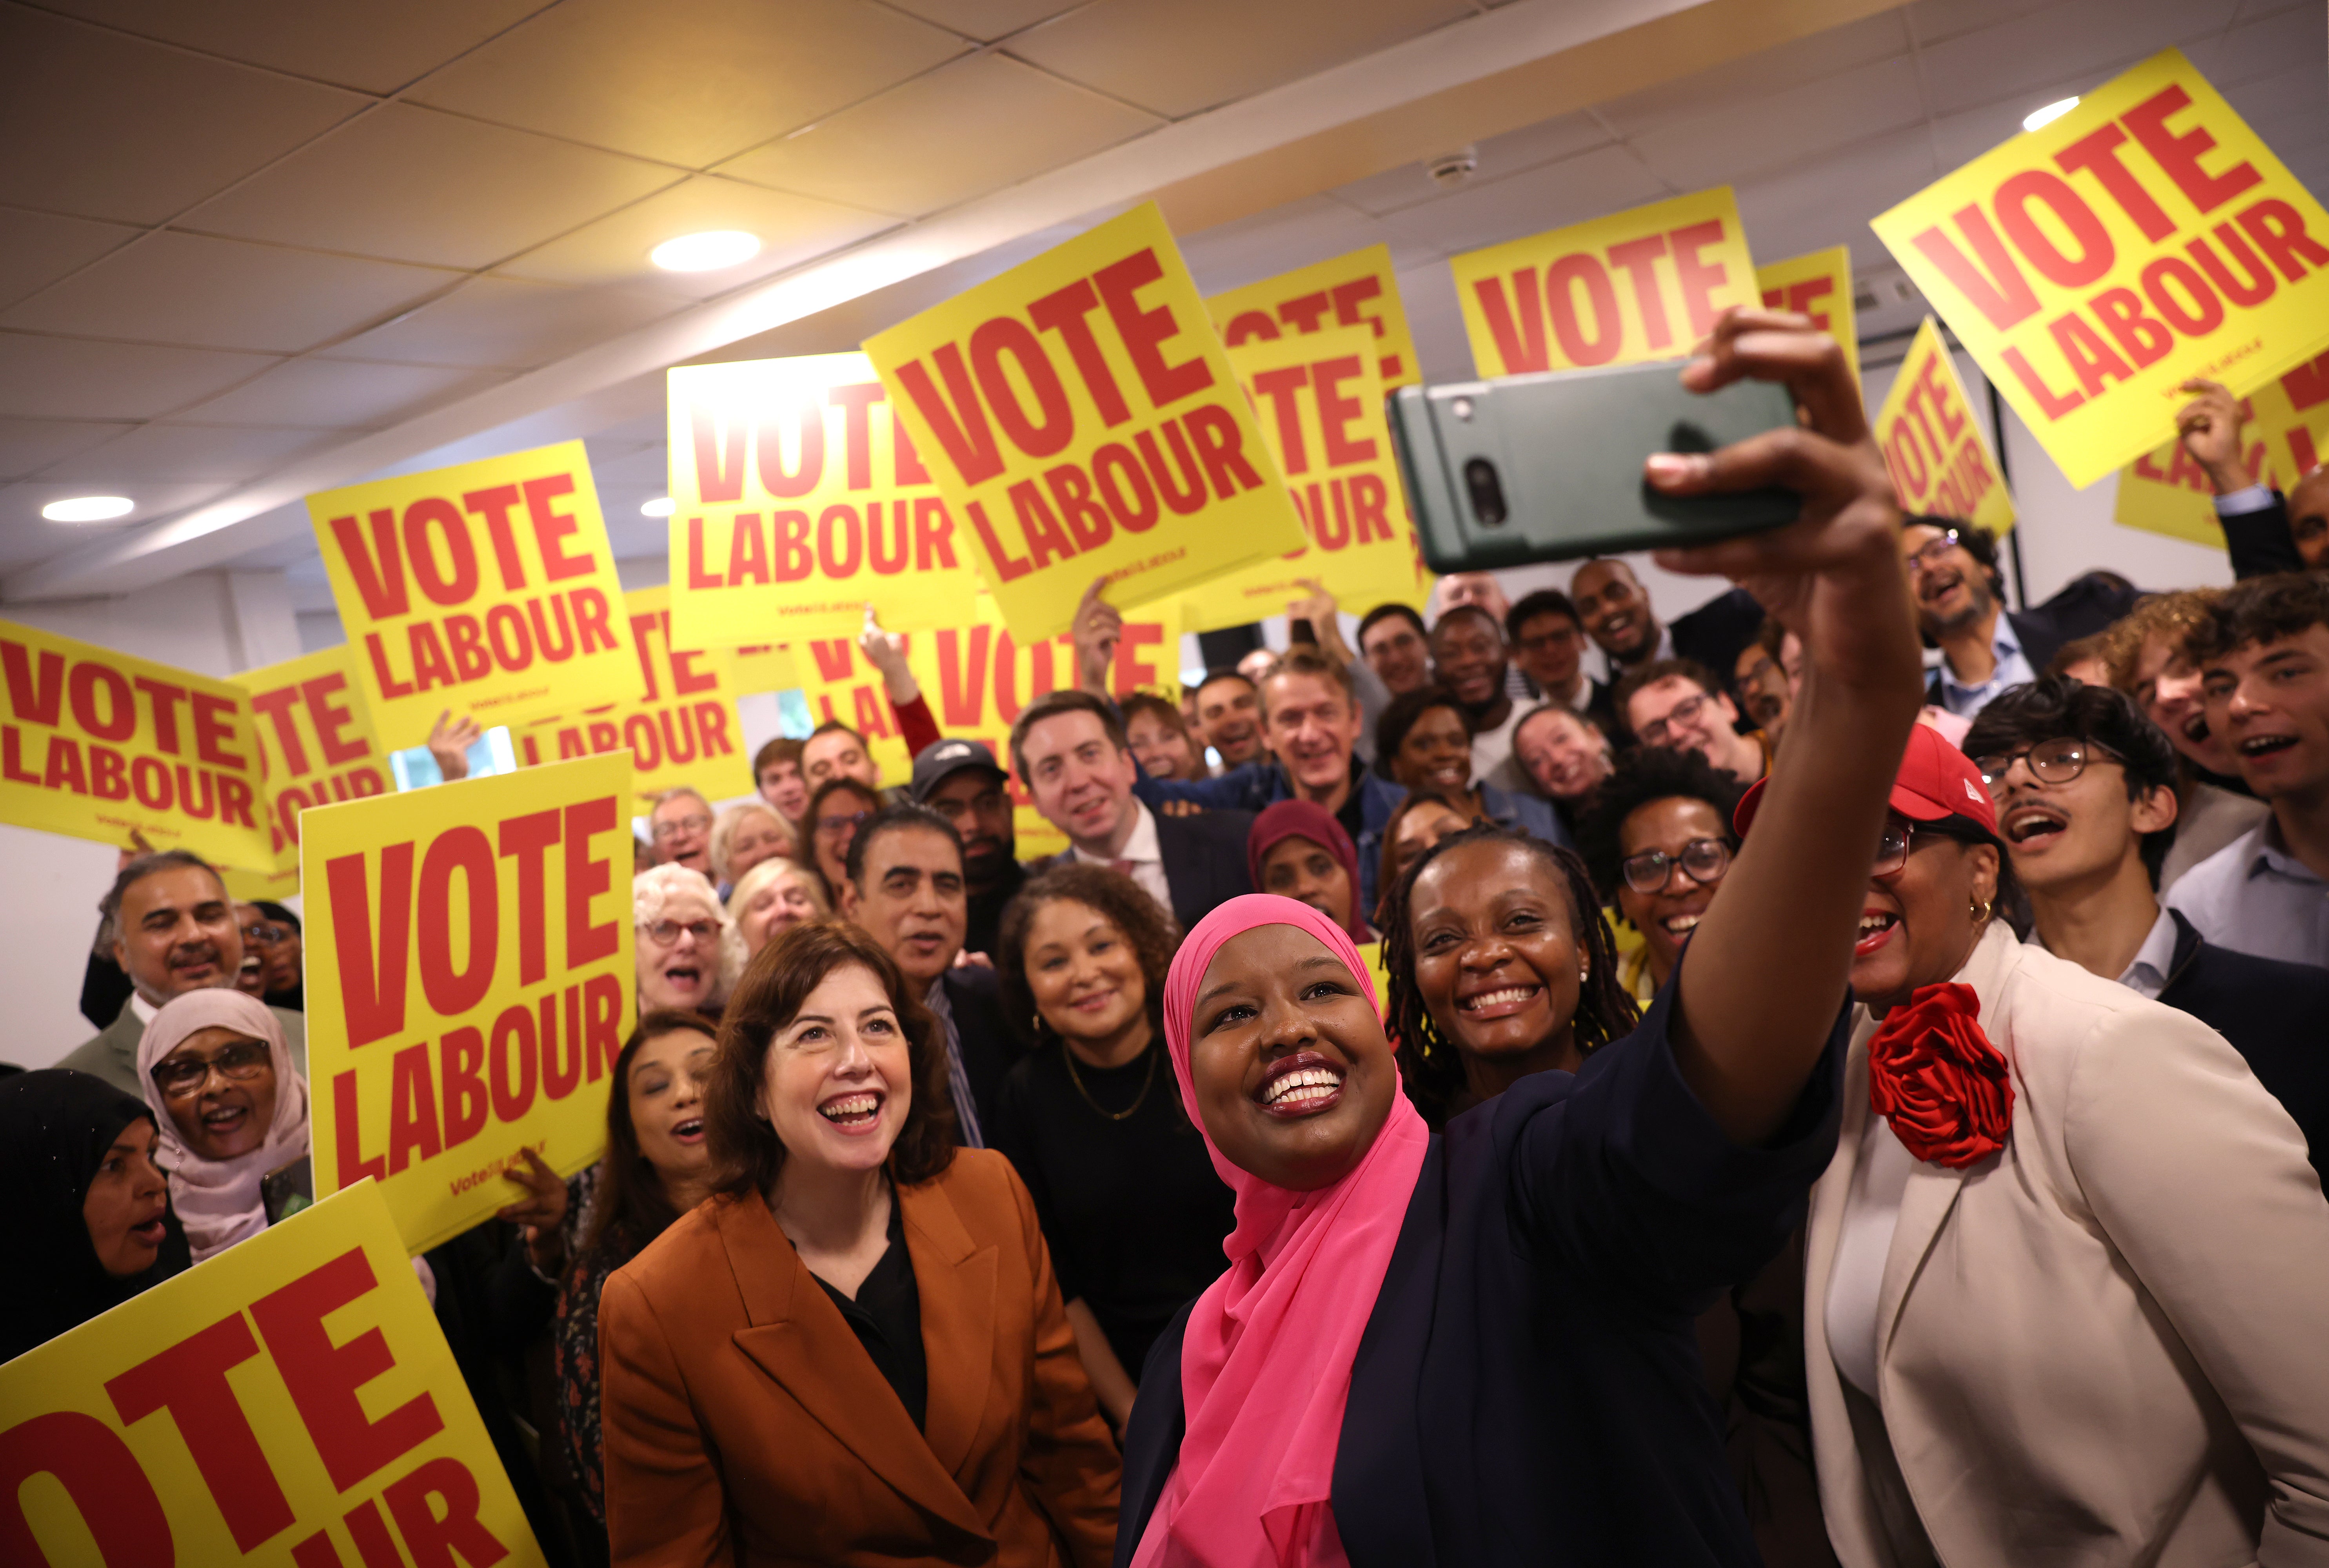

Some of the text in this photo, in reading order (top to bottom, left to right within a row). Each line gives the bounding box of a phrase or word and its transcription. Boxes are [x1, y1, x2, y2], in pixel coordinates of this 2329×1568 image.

[1909, 82, 2264, 334] VOTE
[893, 246, 1216, 489] VOTE
[2000, 197, 2329, 423] LABOUR
[965, 403, 1265, 584] LABOUR
[1240, 354, 1379, 476] TE
[329, 472, 597, 622] VOTE
[688, 497, 960, 590] LABOUR
[0, 637, 247, 771] VOTE
[251, 671, 371, 782] TE
[365, 587, 619, 701] LABOUR
[2, 723, 259, 829] LABOUR
[325, 795, 618, 1051] VOTE
[333, 972, 623, 1192] LABOUR
[0, 1245, 445, 1568] OTE
